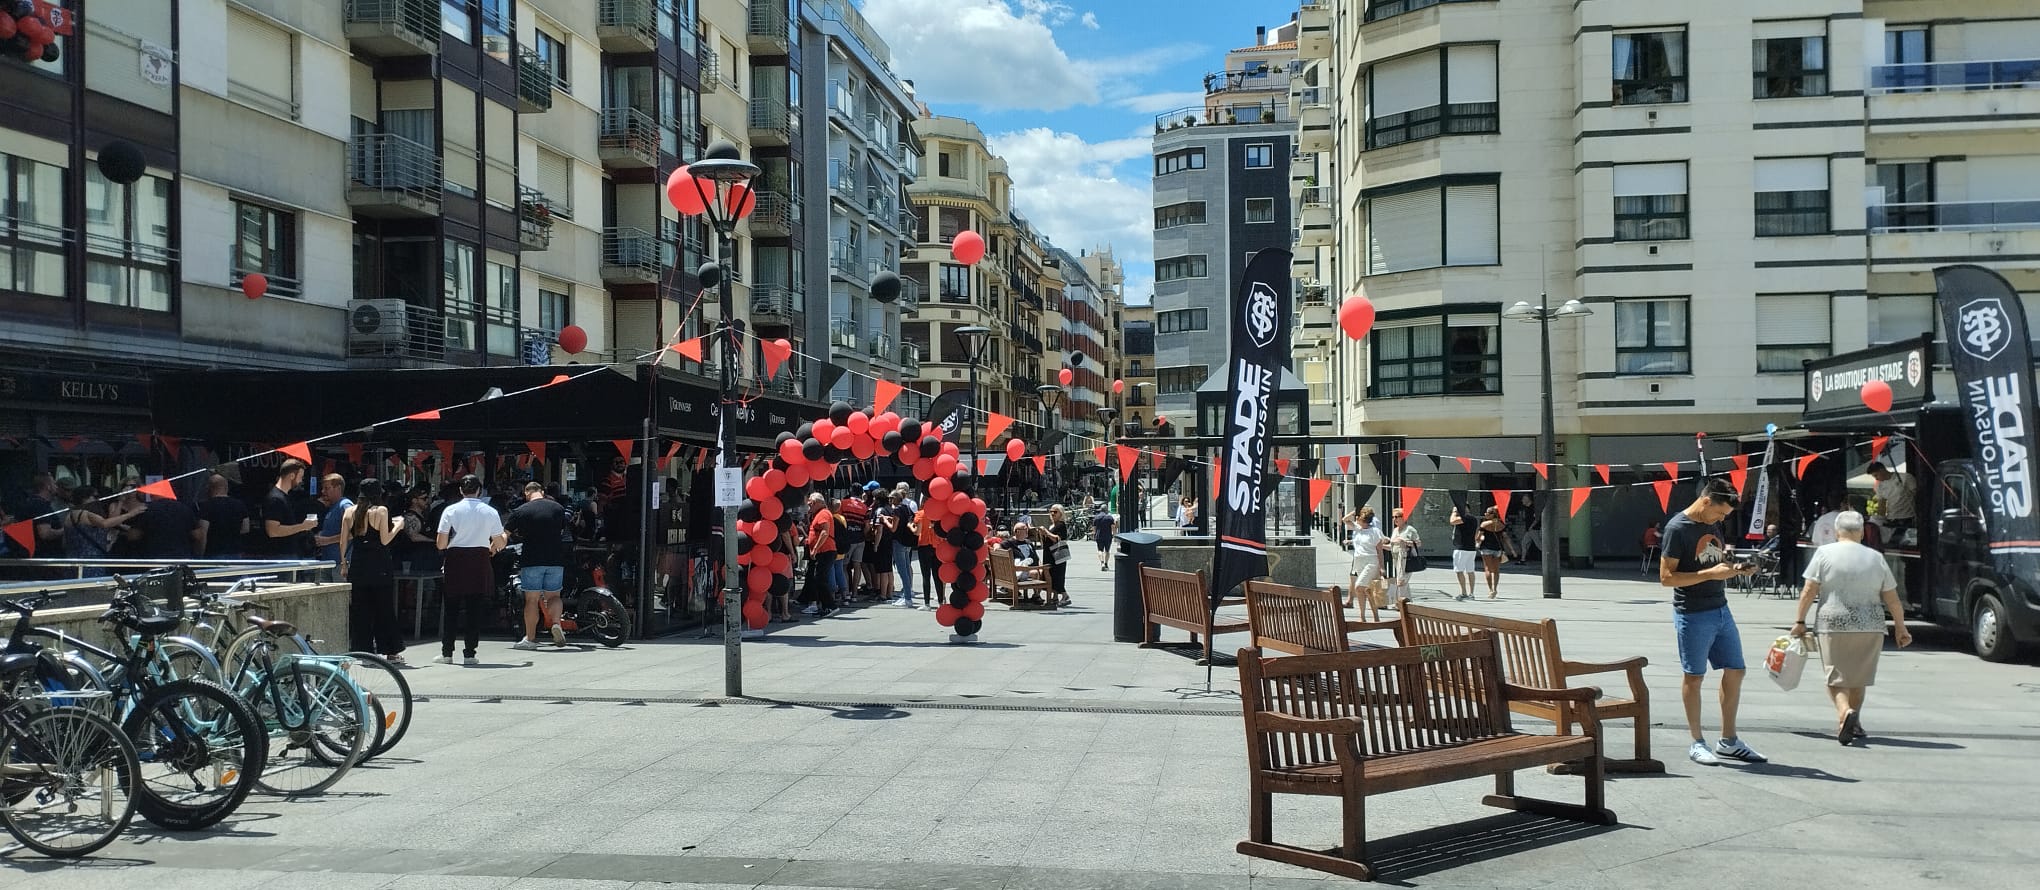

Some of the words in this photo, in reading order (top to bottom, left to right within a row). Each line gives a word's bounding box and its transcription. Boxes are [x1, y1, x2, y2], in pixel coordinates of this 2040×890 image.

[61, 380, 119, 400] KELLY'S
[1825, 375, 1833, 391] LA
[1834, 367, 1867, 390] BOUTIQUE
[1868, 366, 1879, 382] DU
[1879, 360, 1904, 383] STADE
[1228, 358, 1261, 516] STADE
[1251, 368, 1273, 514] TOULOUSAIN
